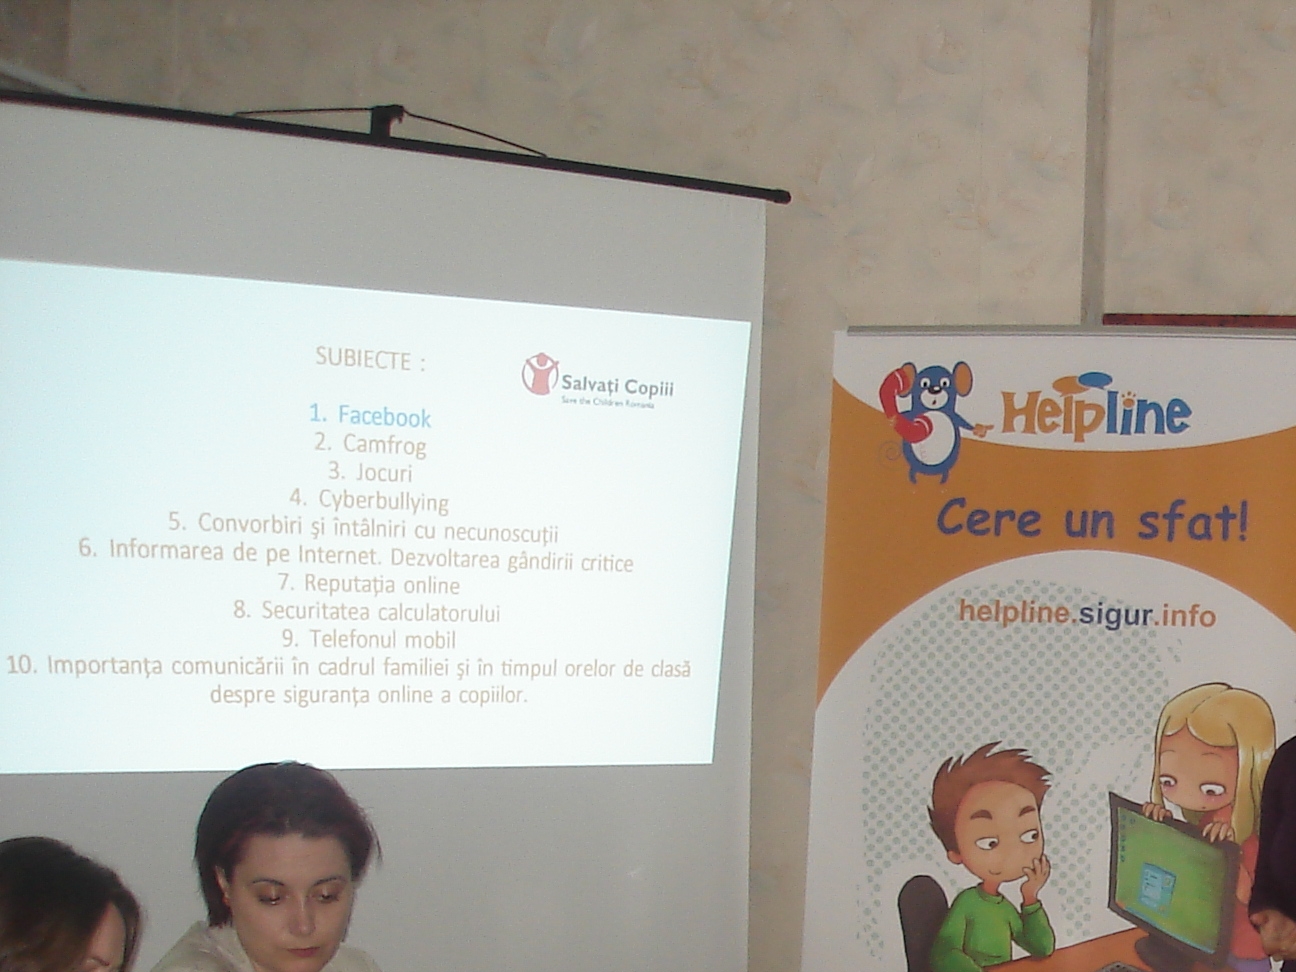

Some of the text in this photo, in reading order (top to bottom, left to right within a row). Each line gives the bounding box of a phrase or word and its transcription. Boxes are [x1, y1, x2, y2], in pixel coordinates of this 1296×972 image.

[315, 346, 412, 371] SUBIECTE
[625, 379, 674, 399] Copiii
[310, 402, 433, 429] 1. Facebook
[1001, 390, 1193, 443] Helpline
[315, 431, 428, 461] 2. Camfrog
[328, 460, 413, 484] 3. Jocuri
[290, 487, 450, 517] 4. Cyberbullying
[168, 511, 188, 531] 5.
[199, 512, 303, 536] Convorbiri
[333, 516, 407, 540] întâlniri
[415, 524, 437, 541] cu
[936, 497, 1249, 543] Cere un sfat!
[79, 537, 635, 575] 6. Informarea de pe Internet. Dezvoltarea gândirii critice
[278, 572, 296, 592] 7.
[404, 575, 462, 596] online
[233, 600, 501, 624] 8. Securitatea calculatorului
[957, 598, 1218, 632] helpline.sigur.info
[282, 628, 457, 651] 9. Telefonul mobil
[6, 655, 38, 675] 10.
[171, 655, 285, 677] comunicării
[292, 655, 310, 677] în
[319, 656, 376, 677] cadrul
[383, 656, 450, 677] familiei
[478, 657, 495, 678] în
[501, 658, 559, 681] timpul
[565, 658, 618, 679] orelor
[624, 658, 645, 679] de
[651, 659, 692, 679] clasă
[210, 683, 277, 709] despre
[378, 684, 434, 705] online
[441, 689, 452, 705] a
[458, 684, 529, 709] copiilor.
